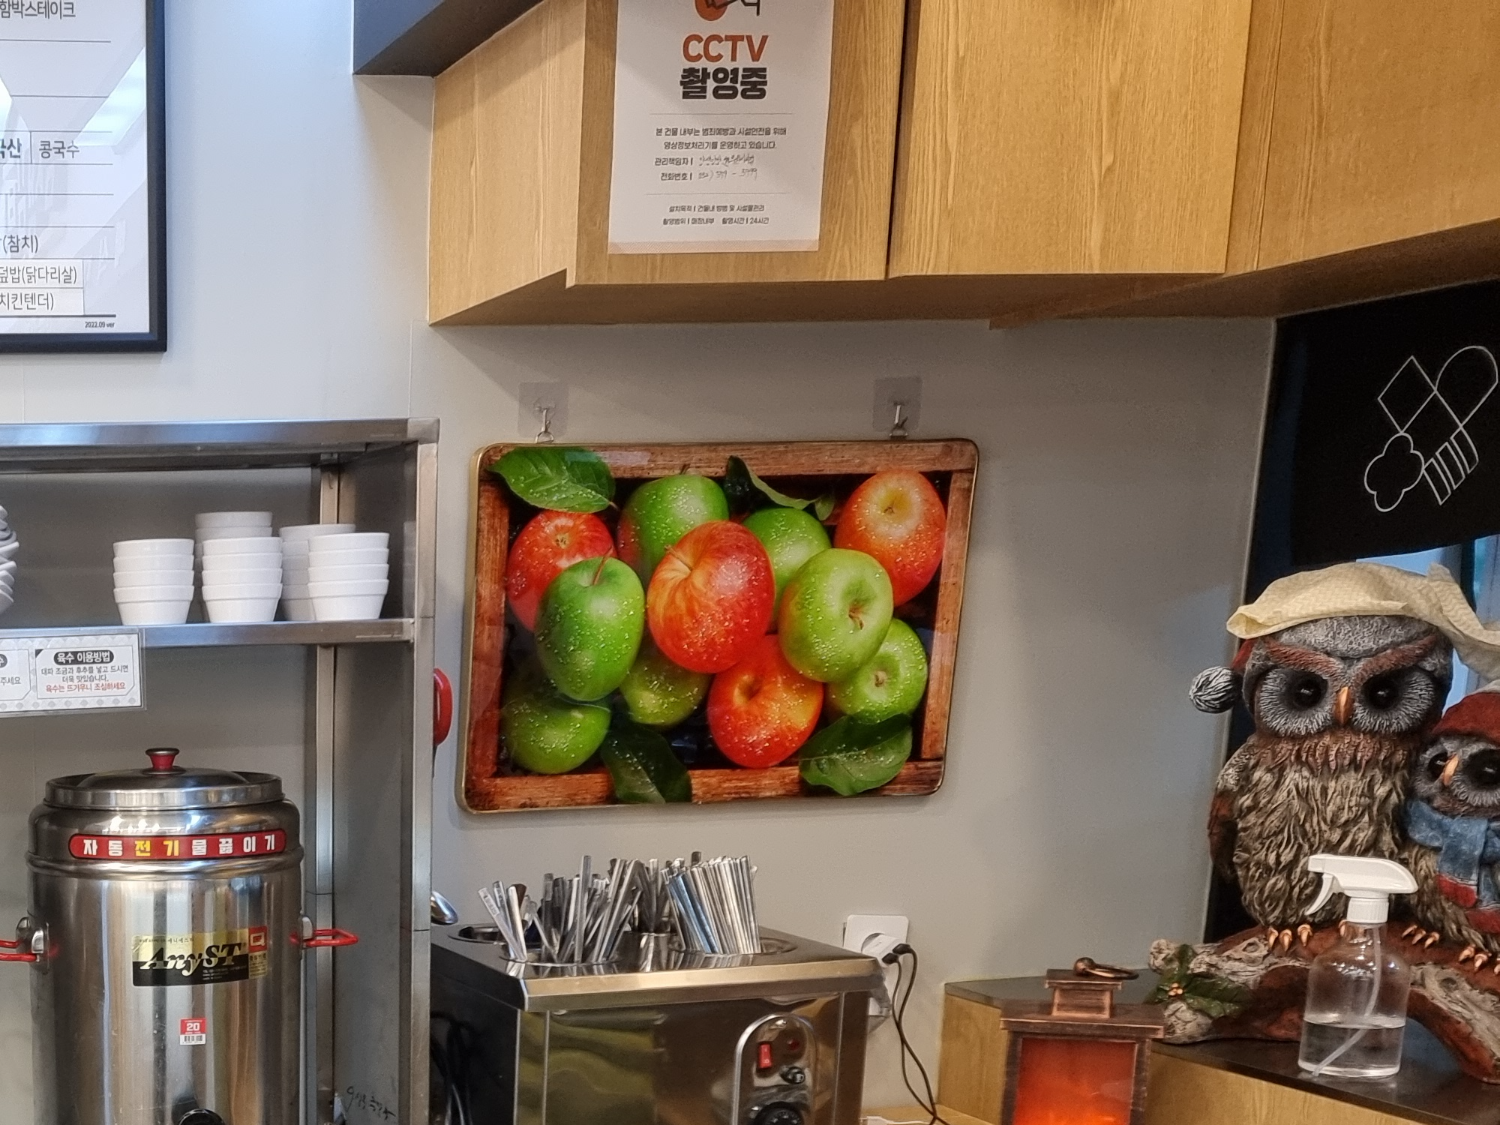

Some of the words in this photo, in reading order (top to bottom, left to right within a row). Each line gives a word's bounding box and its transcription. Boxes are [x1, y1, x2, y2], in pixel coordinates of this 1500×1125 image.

[682, 34, 769, 63] CCTV
[680, 67, 768, 100] 촬영중
[39, 140, 80, 159] 콩국수
[57, 652, 75, 664] 육수
[76, 651, 111, 663] 이용방법
[0, 676, 21, 686] 주세요
[140, 942, 242, 977] AnyST
[186, 1022, 200, 1032] 20
